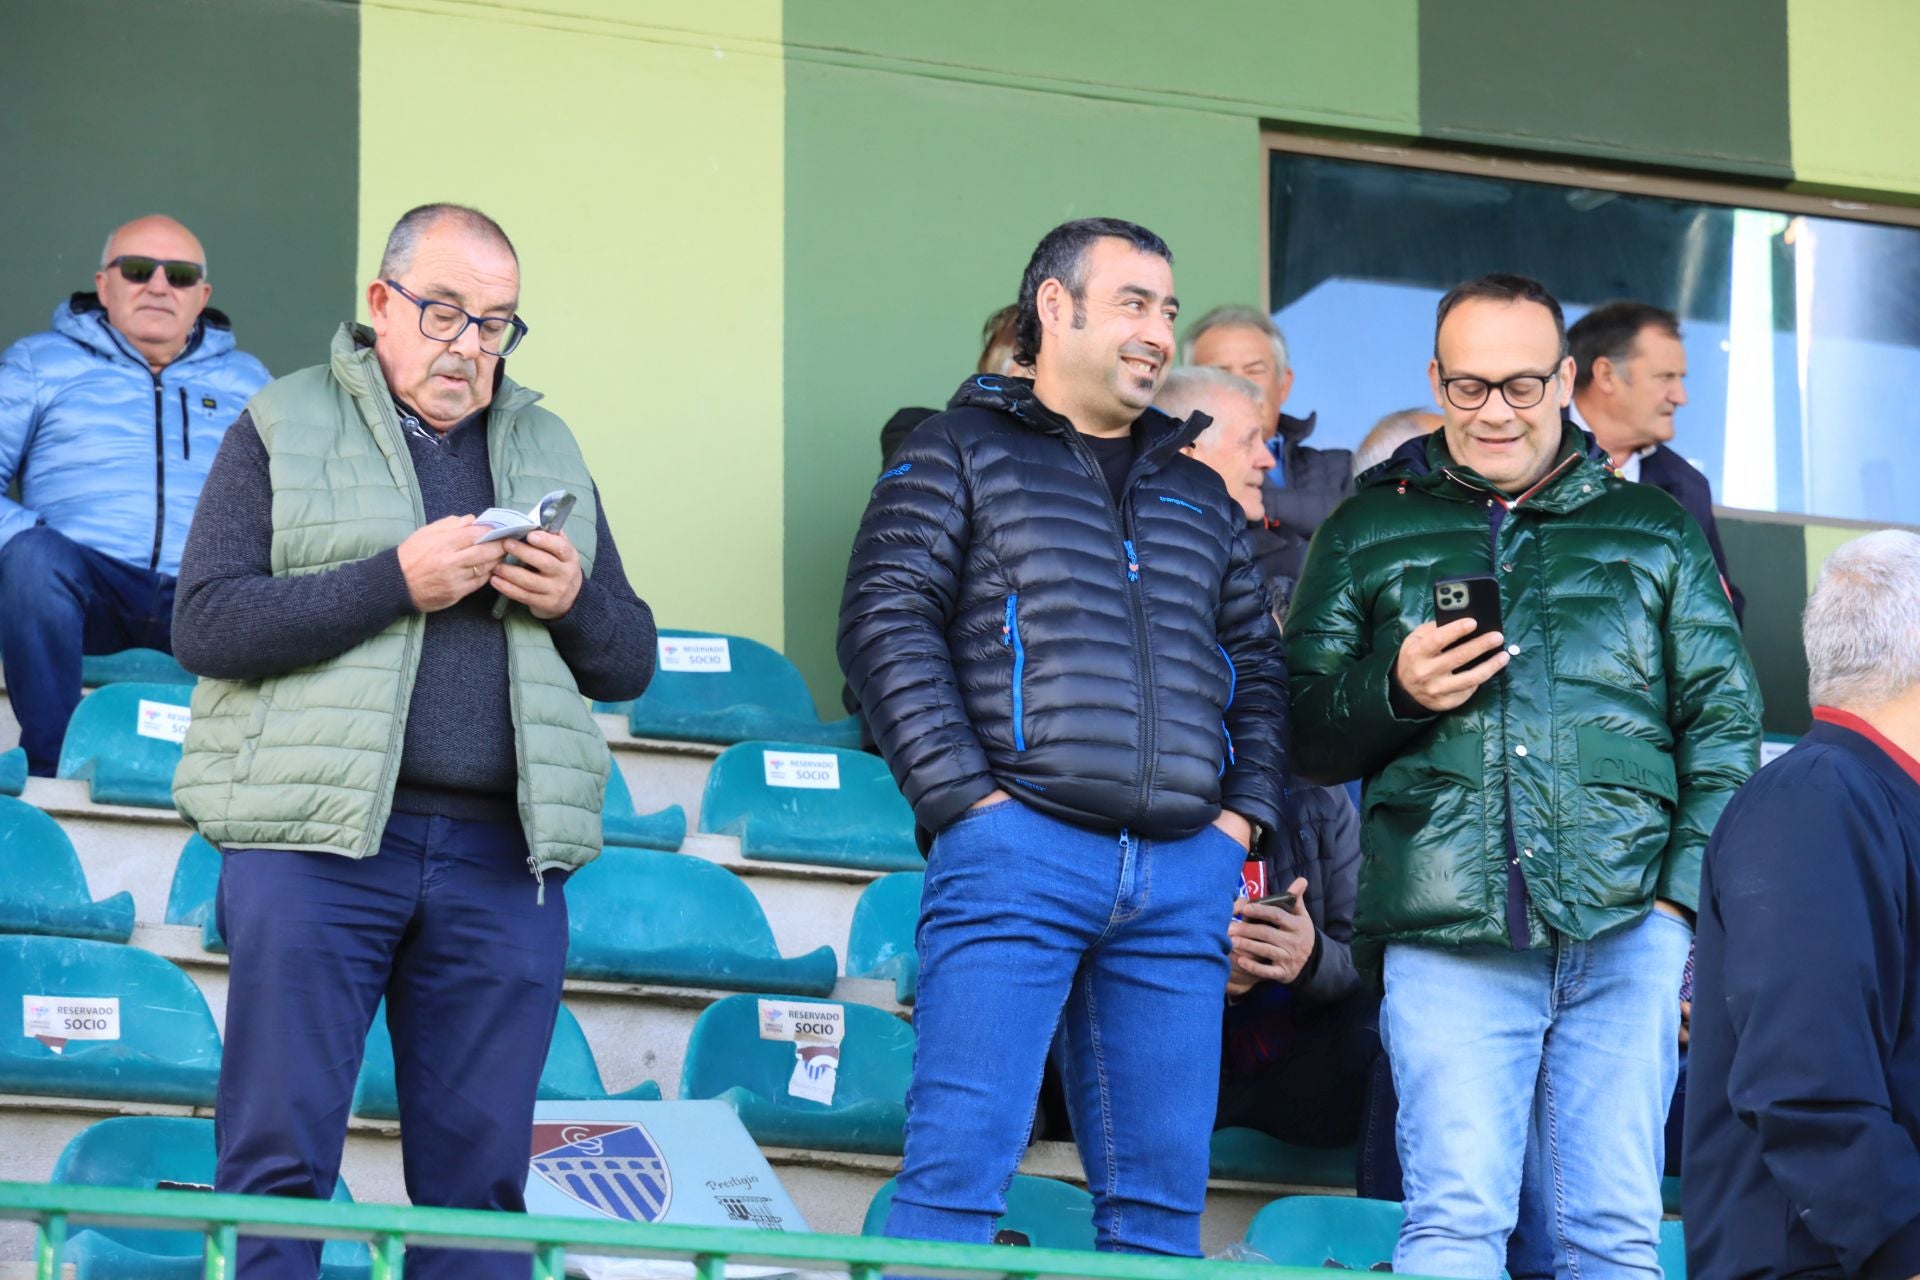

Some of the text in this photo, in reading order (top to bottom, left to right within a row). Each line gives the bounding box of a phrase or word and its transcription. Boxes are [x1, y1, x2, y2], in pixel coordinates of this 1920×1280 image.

[689, 655, 721, 665] SOCIO
[790, 760, 834, 769] RESERVADO
[796, 770, 830, 781] SOCIO
[57, 1006, 113, 1016] RESERVADO
[788, 1010, 840, 1021] RESERVADO
[64, 1018, 107, 1031] SOCIO
[795, 1022, 834, 1035] SOCIO
[705, 1174, 760, 1191] Prestigio
